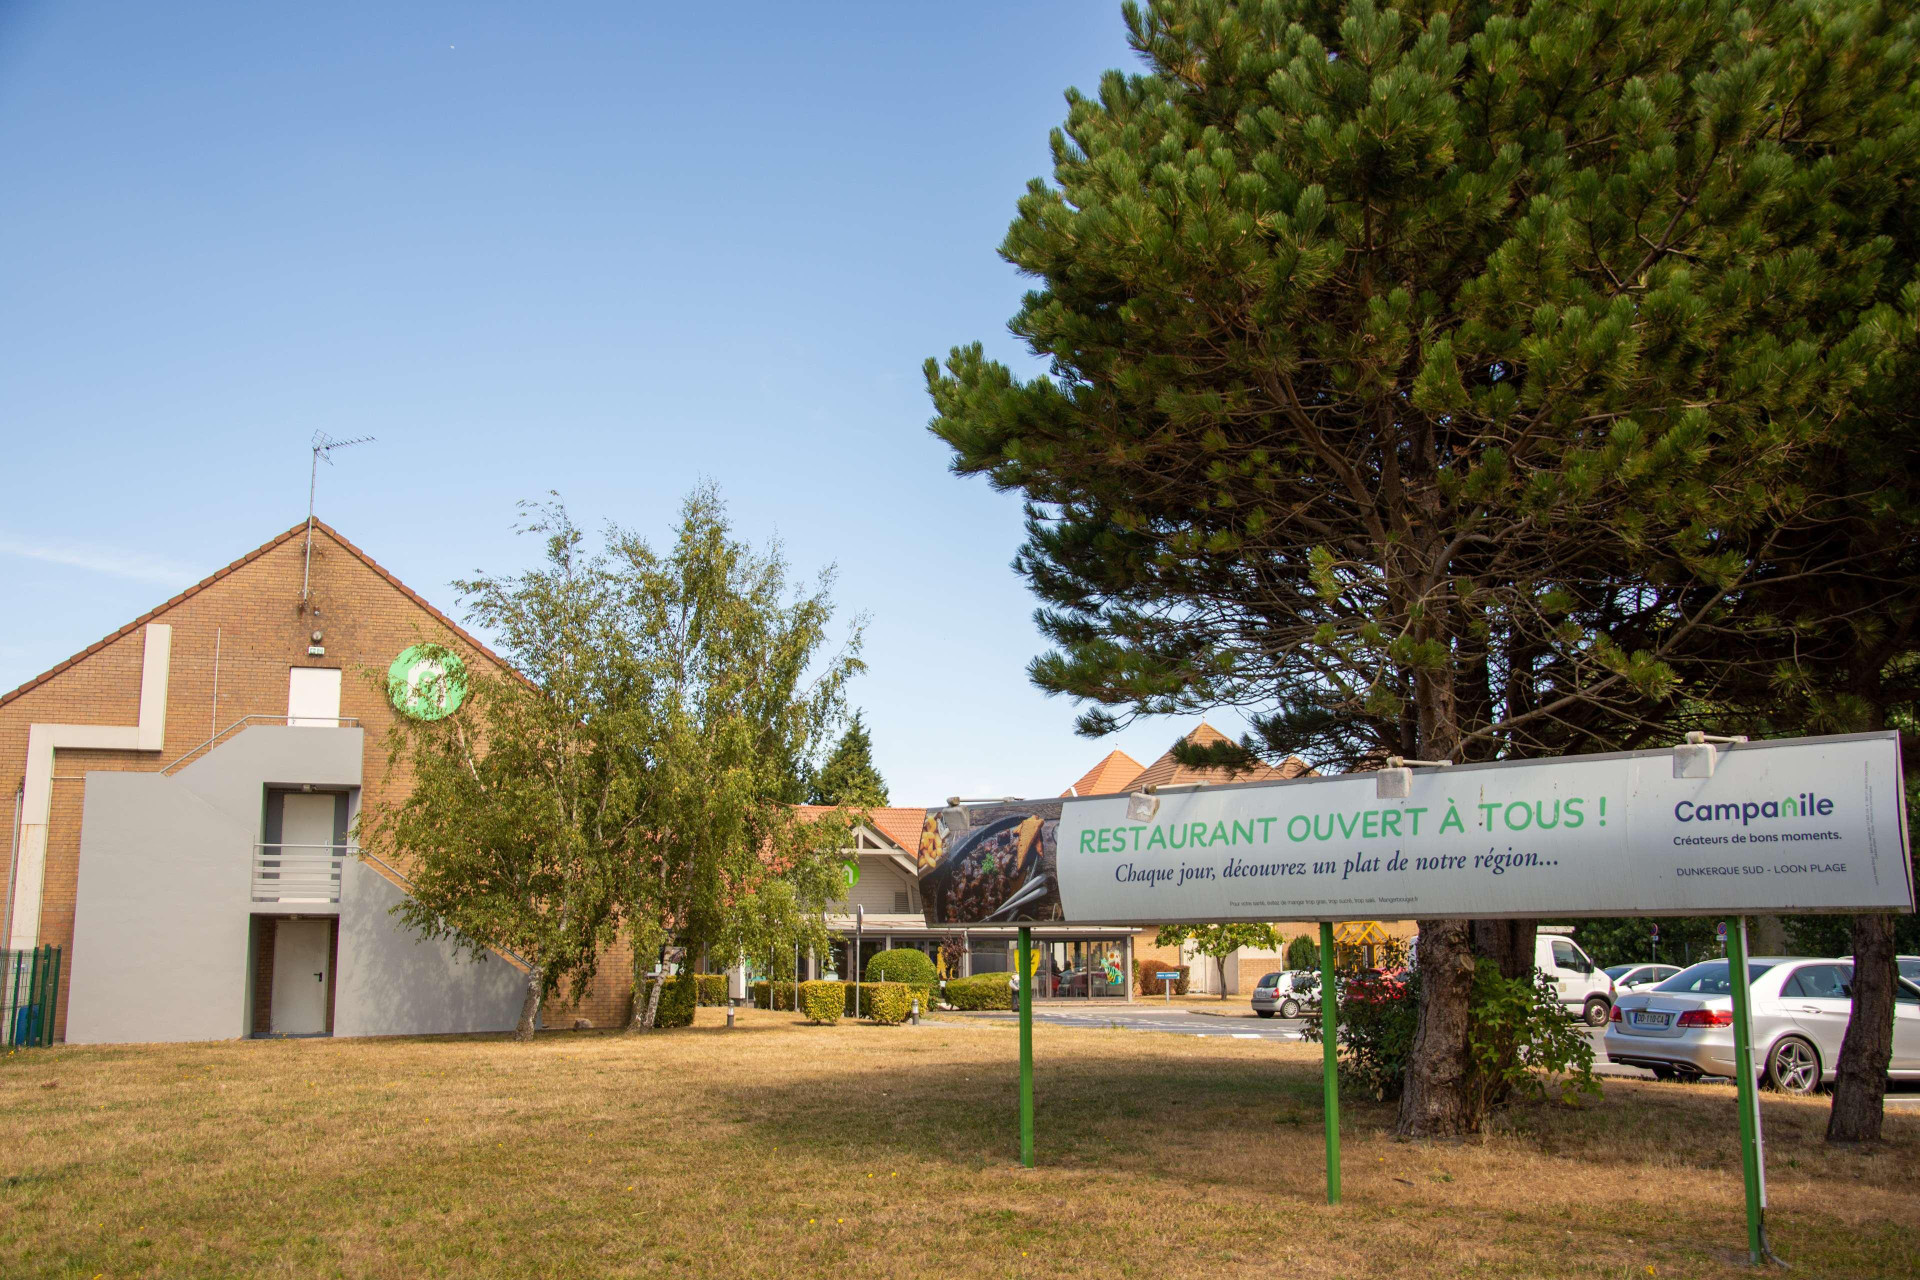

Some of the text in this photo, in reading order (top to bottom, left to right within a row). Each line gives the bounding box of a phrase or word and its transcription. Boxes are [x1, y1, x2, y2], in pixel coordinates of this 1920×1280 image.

[1080, 817, 1277, 854] RESTAURANT
[1287, 807, 1428, 842] OUVERT
[1439, 797, 1465, 835] À
[1478, 798, 1584, 832] TOUS
[1674, 792, 1834, 826] Campanile
[1673, 830, 1842, 846] Créateurs de bons moments.
[1115, 847, 1559, 887] Chaque jour, découvrez un plat de notre région...
[1676, 866, 1740, 877] DUNKERQUE
[1742, 865, 1764, 875] SUD
[1774, 864, 1807, 874] LOON
[1810, 863, 1847, 873] PLAGE
